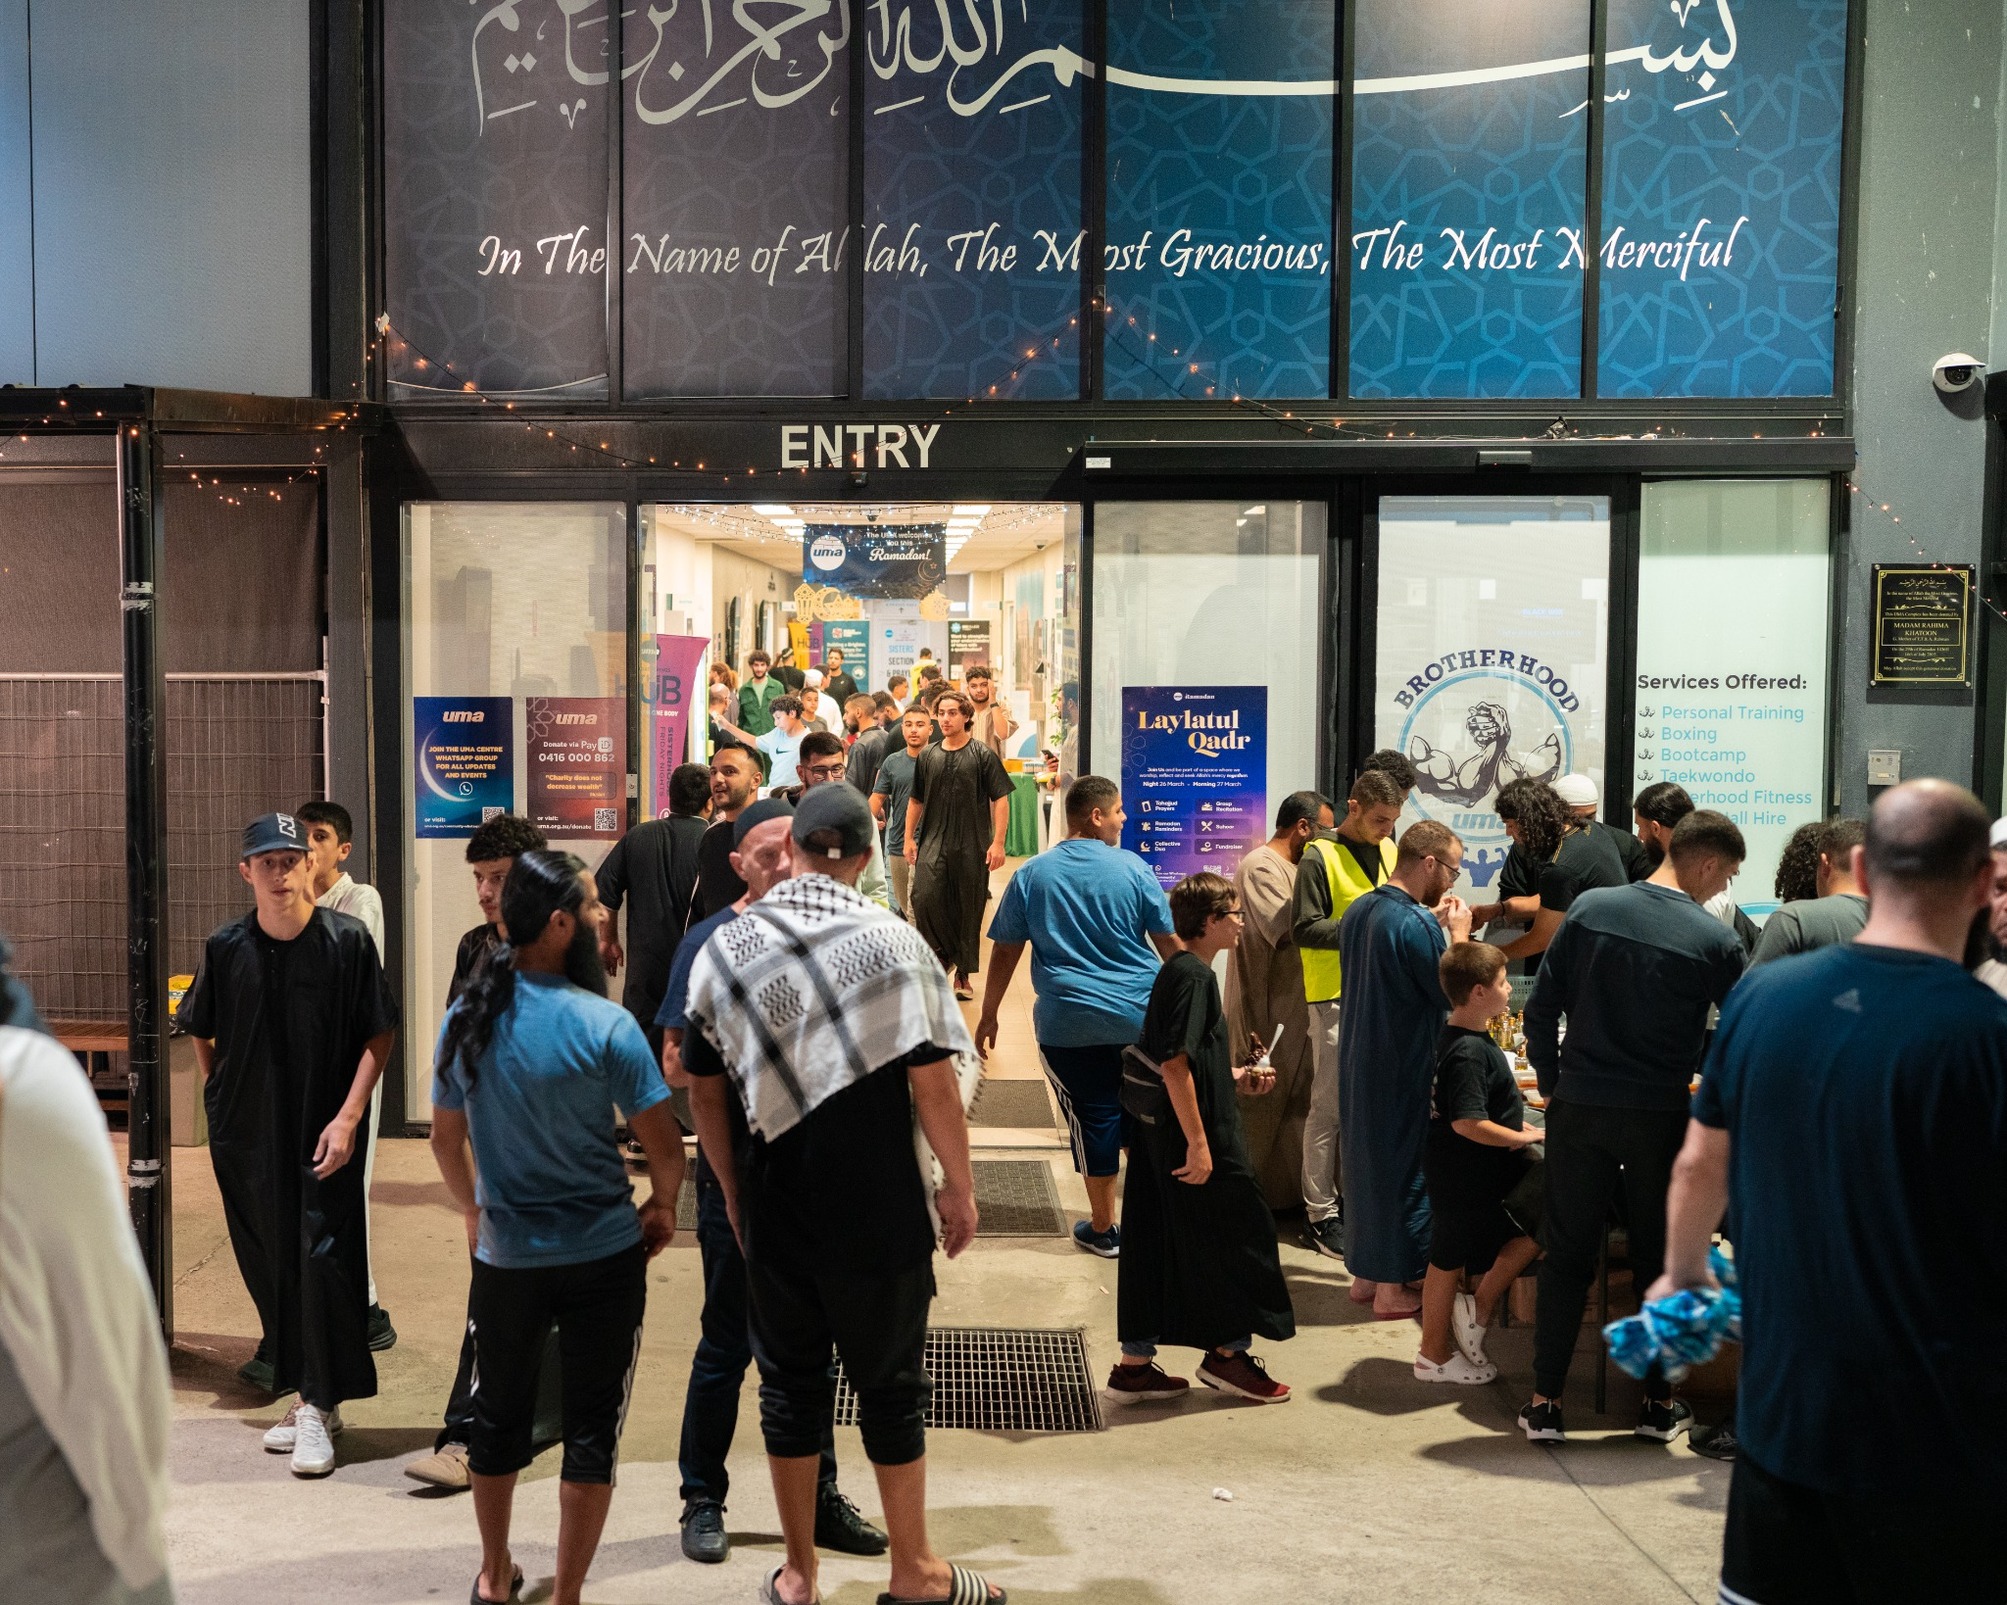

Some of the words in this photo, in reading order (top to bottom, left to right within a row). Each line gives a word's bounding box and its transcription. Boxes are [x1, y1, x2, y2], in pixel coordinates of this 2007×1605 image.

[478, 235, 522, 276] In
[536, 224, 607, 276] The
[626, 232, 741, 275] Name
[750, 224, 797, 287] of
[946, 221, 1018, 272] The
[1160, 227, 1330, 278] Gracious,
[1351, 219, 1424, 270] The
[1439, 225, 1546, 270] Most
[781, 424, 942, 469] ENTRY
[813, 548, 843, 558] uma
[869, 548, 932, 562] Ramadan!
[888, 645, 914, 653] SISTERS
[888, 657, 914, 665] SECTION
[1394, 650, 1580, 712] BROTHERHOOD
[1637, 674, 1719, 689] Services
[1726, 674, 1807, 689] Offered:
[442, 711, 485, 722] uma
[556, 714, 598, 724] uma
[1662, 706, 1733, 719] Personal
[1738, 705, 1804, 723] Training
[1138, 709, 1239, 734] Laylatul
[1662, 727, 1717, 743] Boxing
[1188, 730, 1251, 758] Qadr
[539, 753, 565, 762] 0416
[568, 753, 592, 762] 000
[595, 753, 615, 762] 862
[1661, 748, 1746, 764] Bootcamp
[1660, 769, 1755, 782] Taekwondo
[1754, 790, 1812, 804] Fitness
[1726, 811, 1748, 824] all
[1754, 811, 1786, 824] Hire
